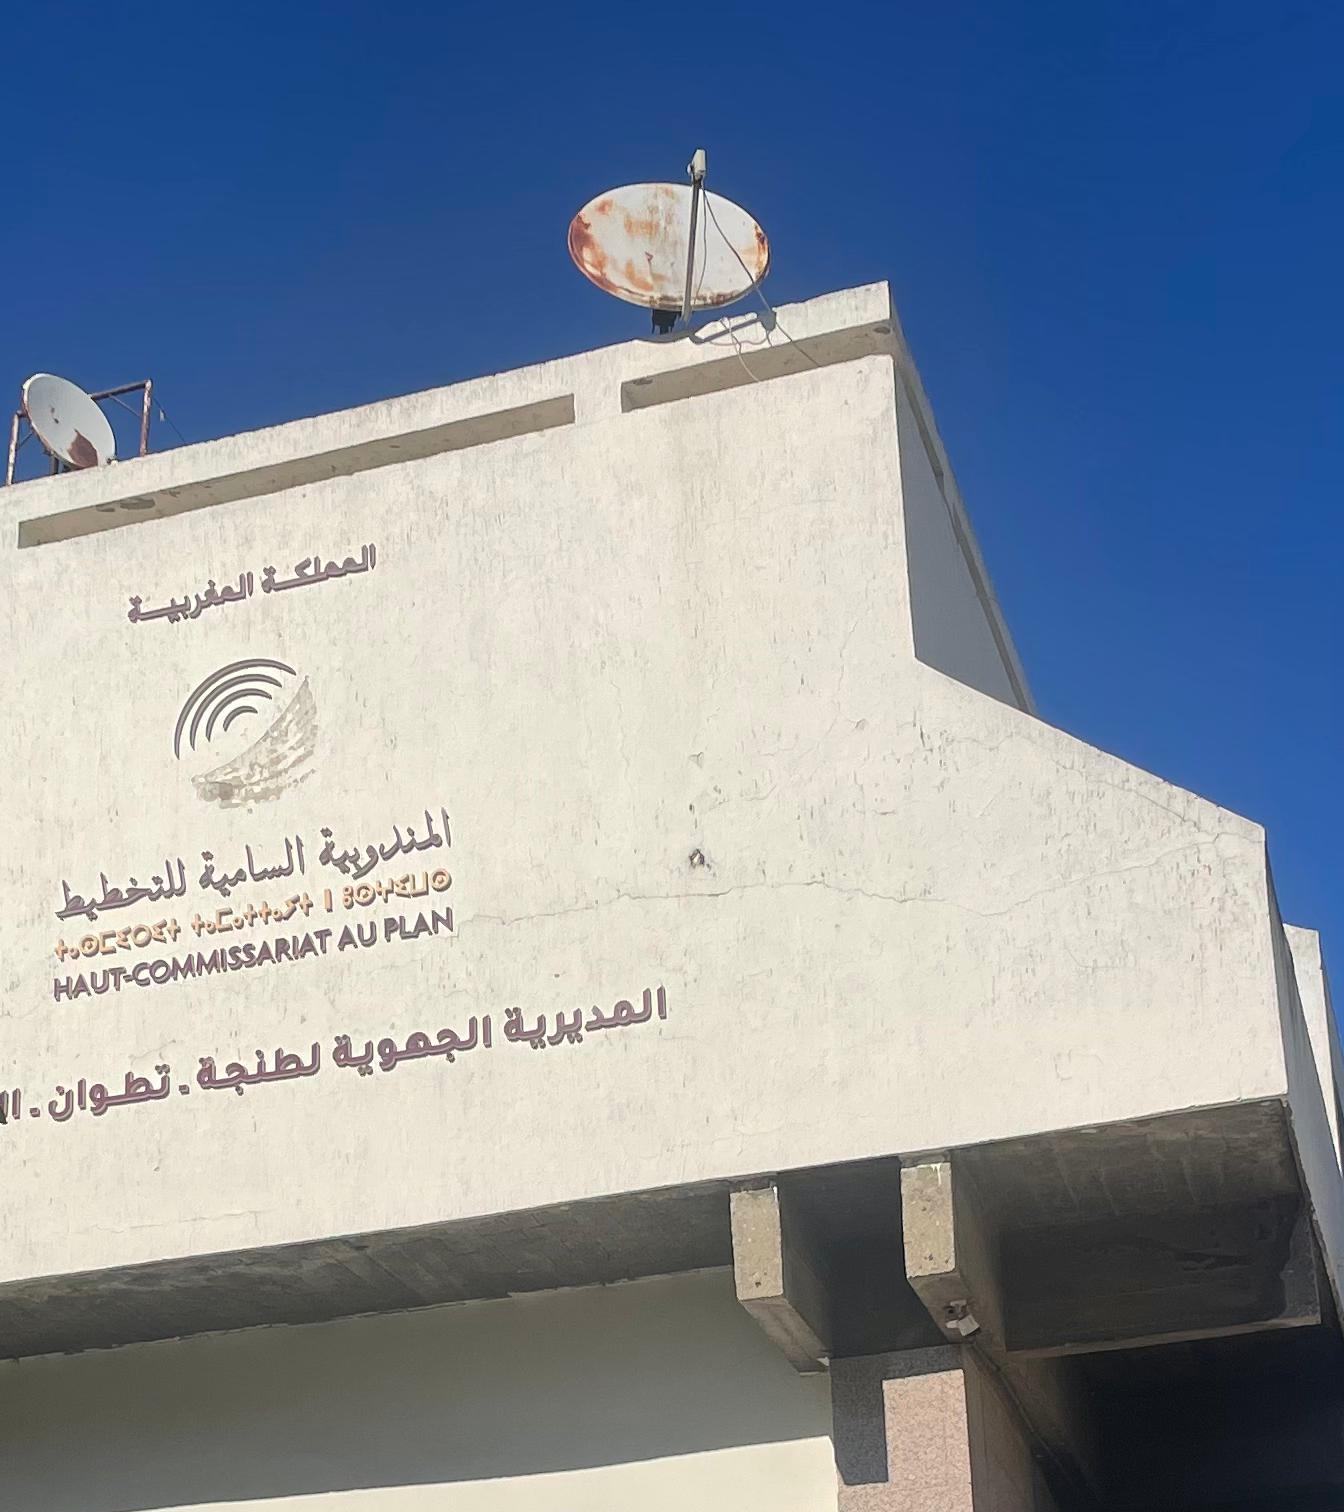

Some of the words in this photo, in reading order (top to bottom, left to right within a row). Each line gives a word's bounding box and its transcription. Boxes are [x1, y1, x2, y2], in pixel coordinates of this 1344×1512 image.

[127, 571, 254, 624] المغربية
[261, 543, 377, 594] المملكة
[199, 835, 305, 897] السامية
[319, 807, 452, 881] المندوبية
[55, 857, 187, 921] للتخطيط
[54, 928, 333, 1002] HAUT-COMMISSARIAT
[337, 920, 378, 952] AU
[384, 906, 455, 943] PLAN
[332, 1015, 492, 1078] الجهوية
[503, 986, 668, 1050] المديرية
[48, 1065, 171, 1123] تطوان
[196, 1042, 321, 1095] لطنجة
